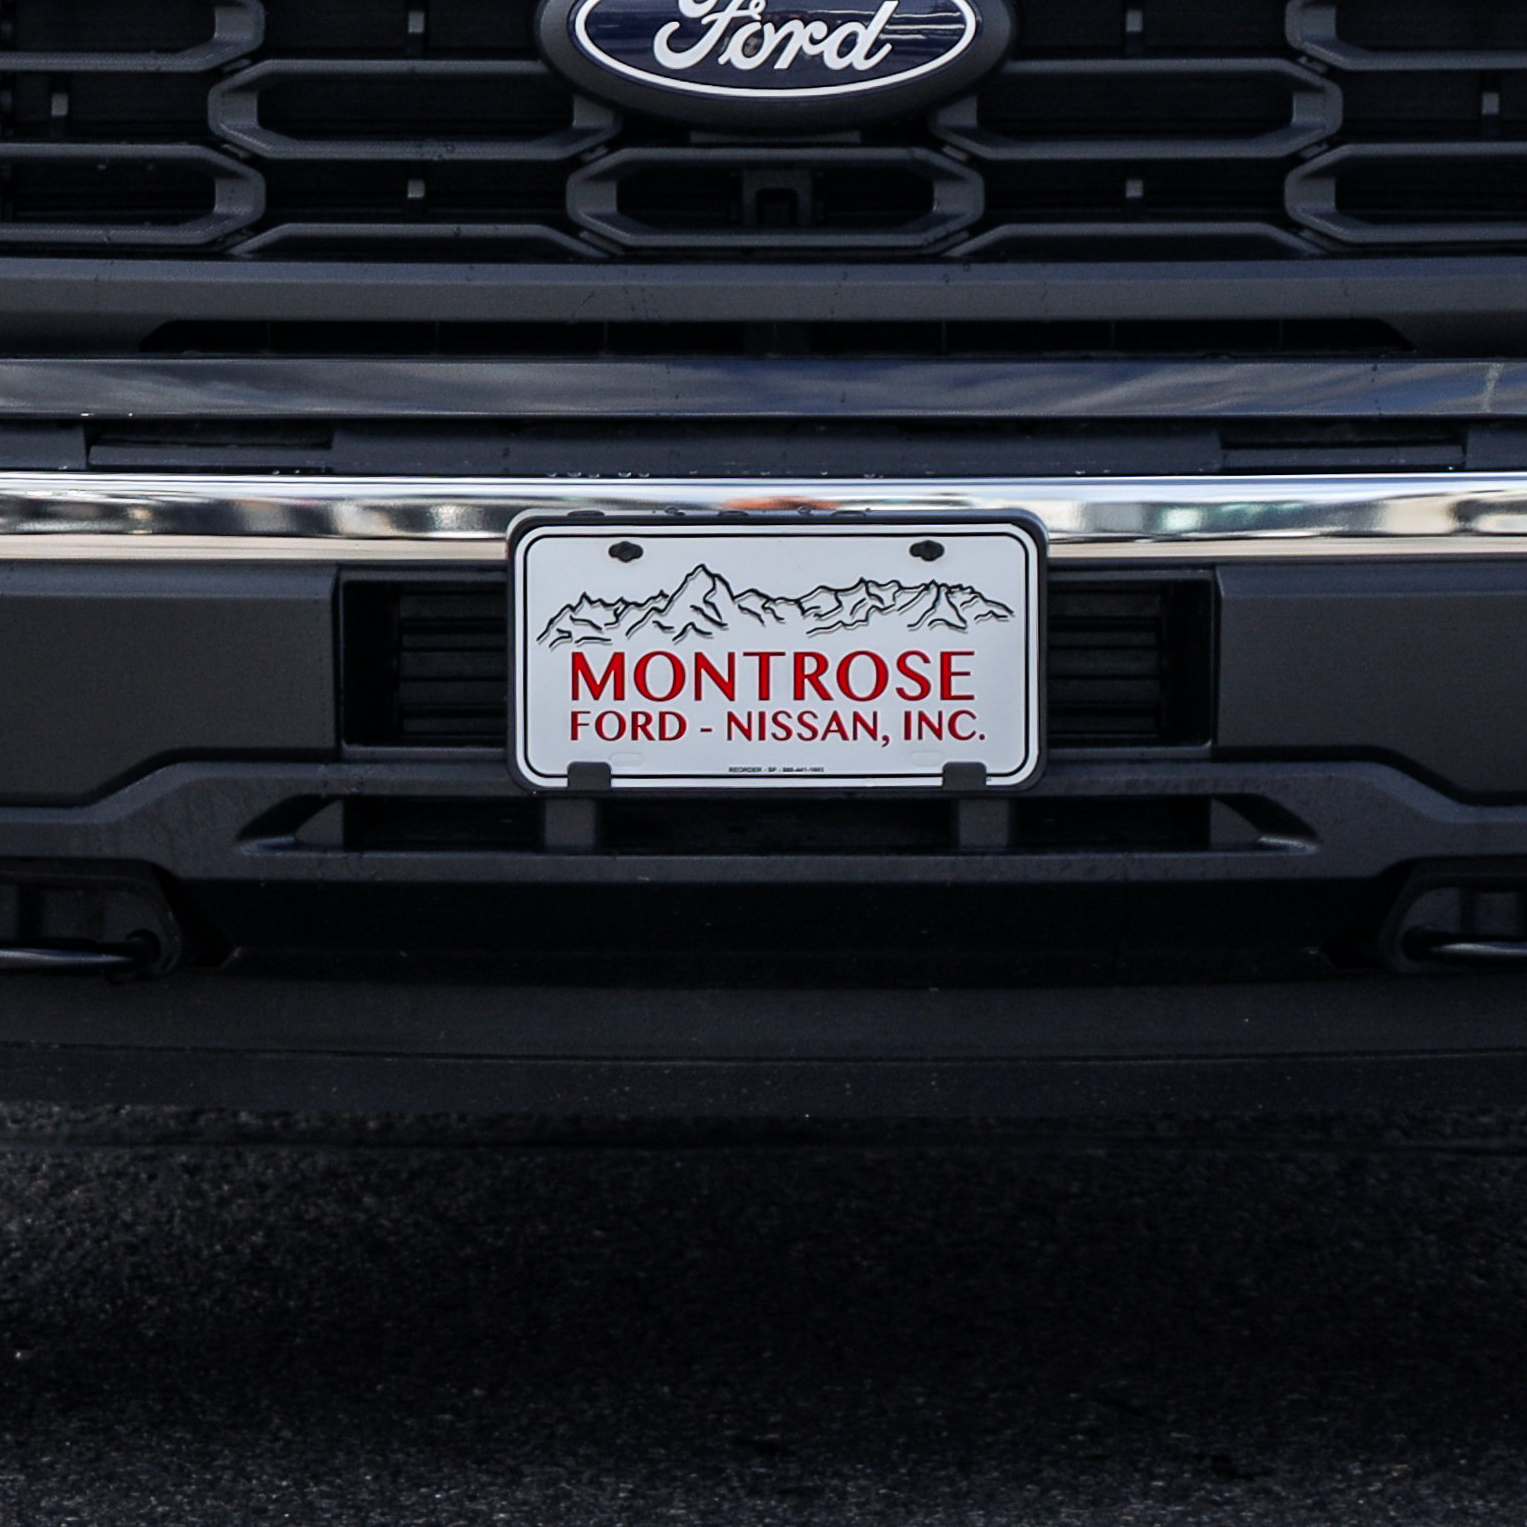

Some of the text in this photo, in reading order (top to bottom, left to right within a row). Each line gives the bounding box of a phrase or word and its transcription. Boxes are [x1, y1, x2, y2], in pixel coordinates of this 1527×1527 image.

[570, 649, 975, 703] MONTROSE
[570, 710, 687, 742] FORD
[726, 710, 891, 747] NISSAN,
[904, 710, 986, 742] INC.
